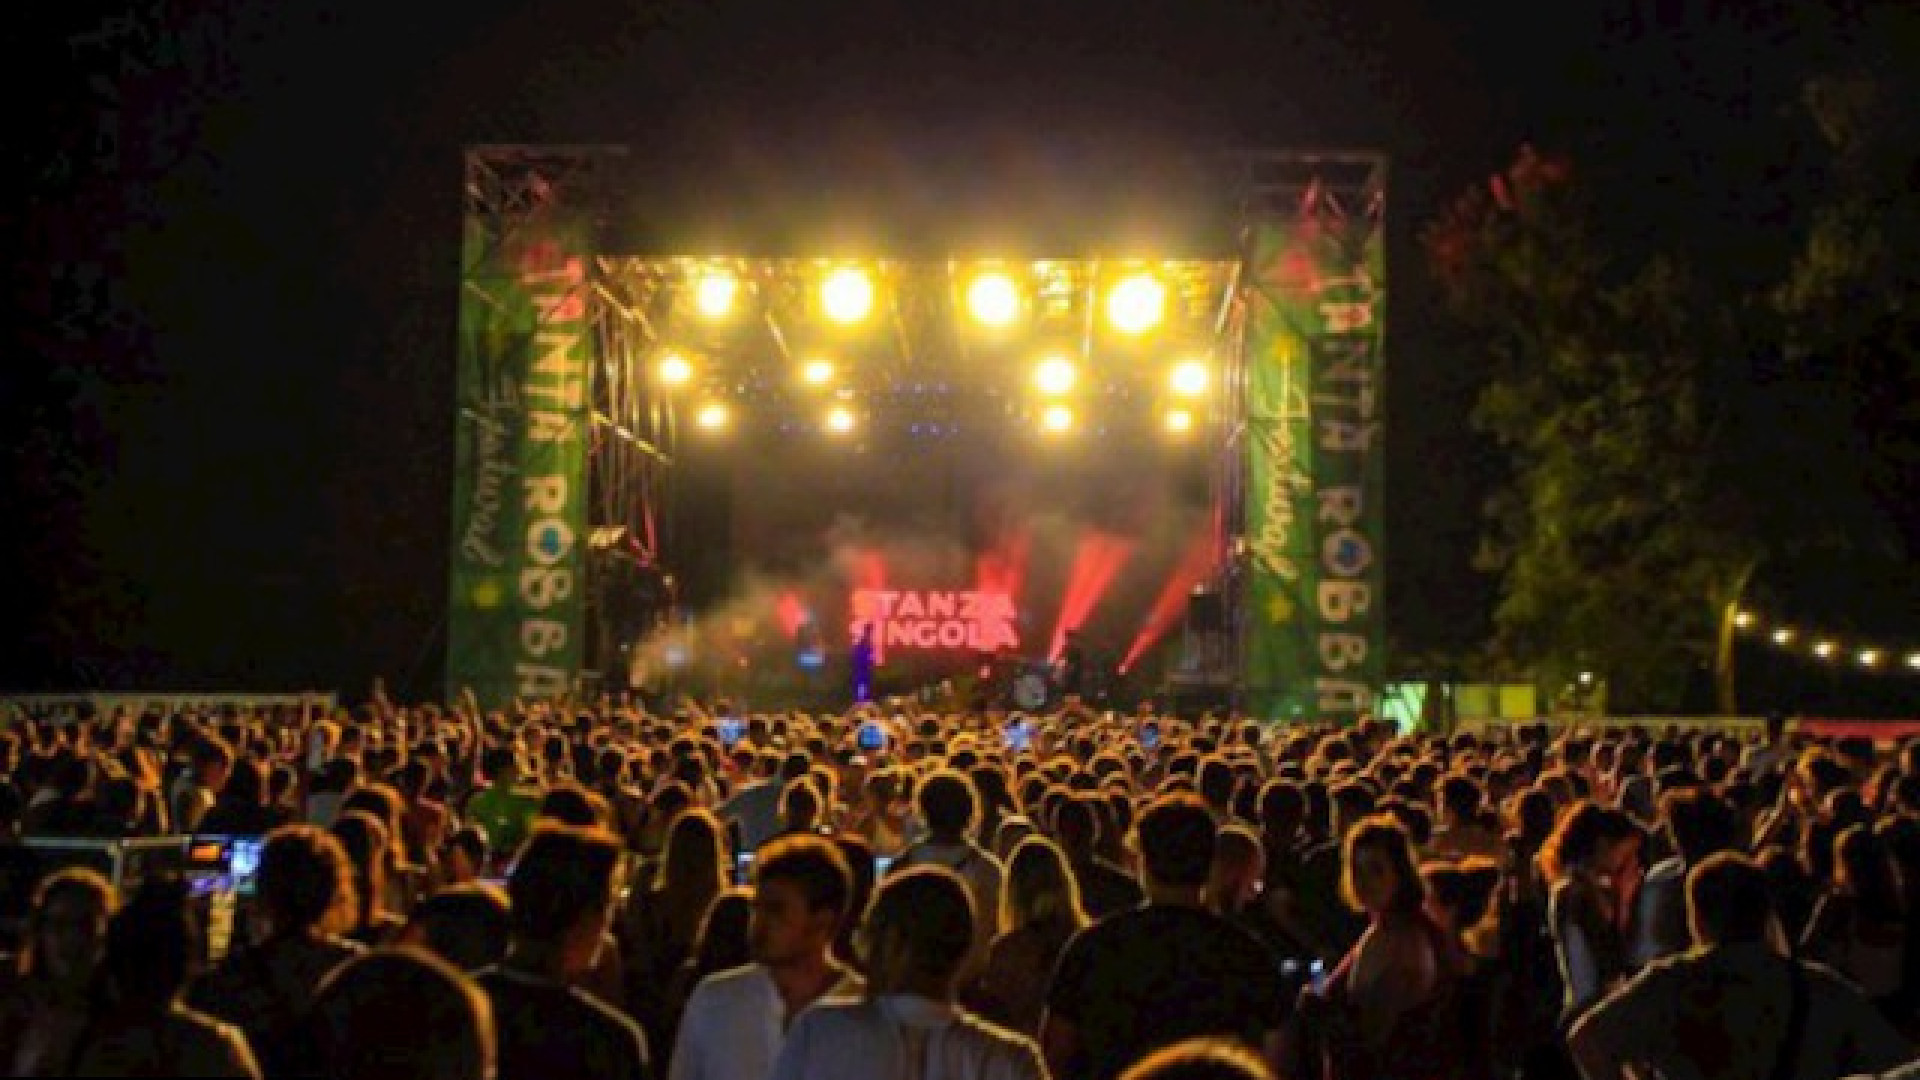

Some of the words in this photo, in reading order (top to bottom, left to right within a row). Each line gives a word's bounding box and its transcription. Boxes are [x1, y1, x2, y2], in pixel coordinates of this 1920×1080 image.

[522, 255, 585, 443] TANTA
[1313, 264, 1374, 452] TANTA
[515, 473, 577, 697] ROBBA
[1314, 486, 1374, 711] ROBBA
